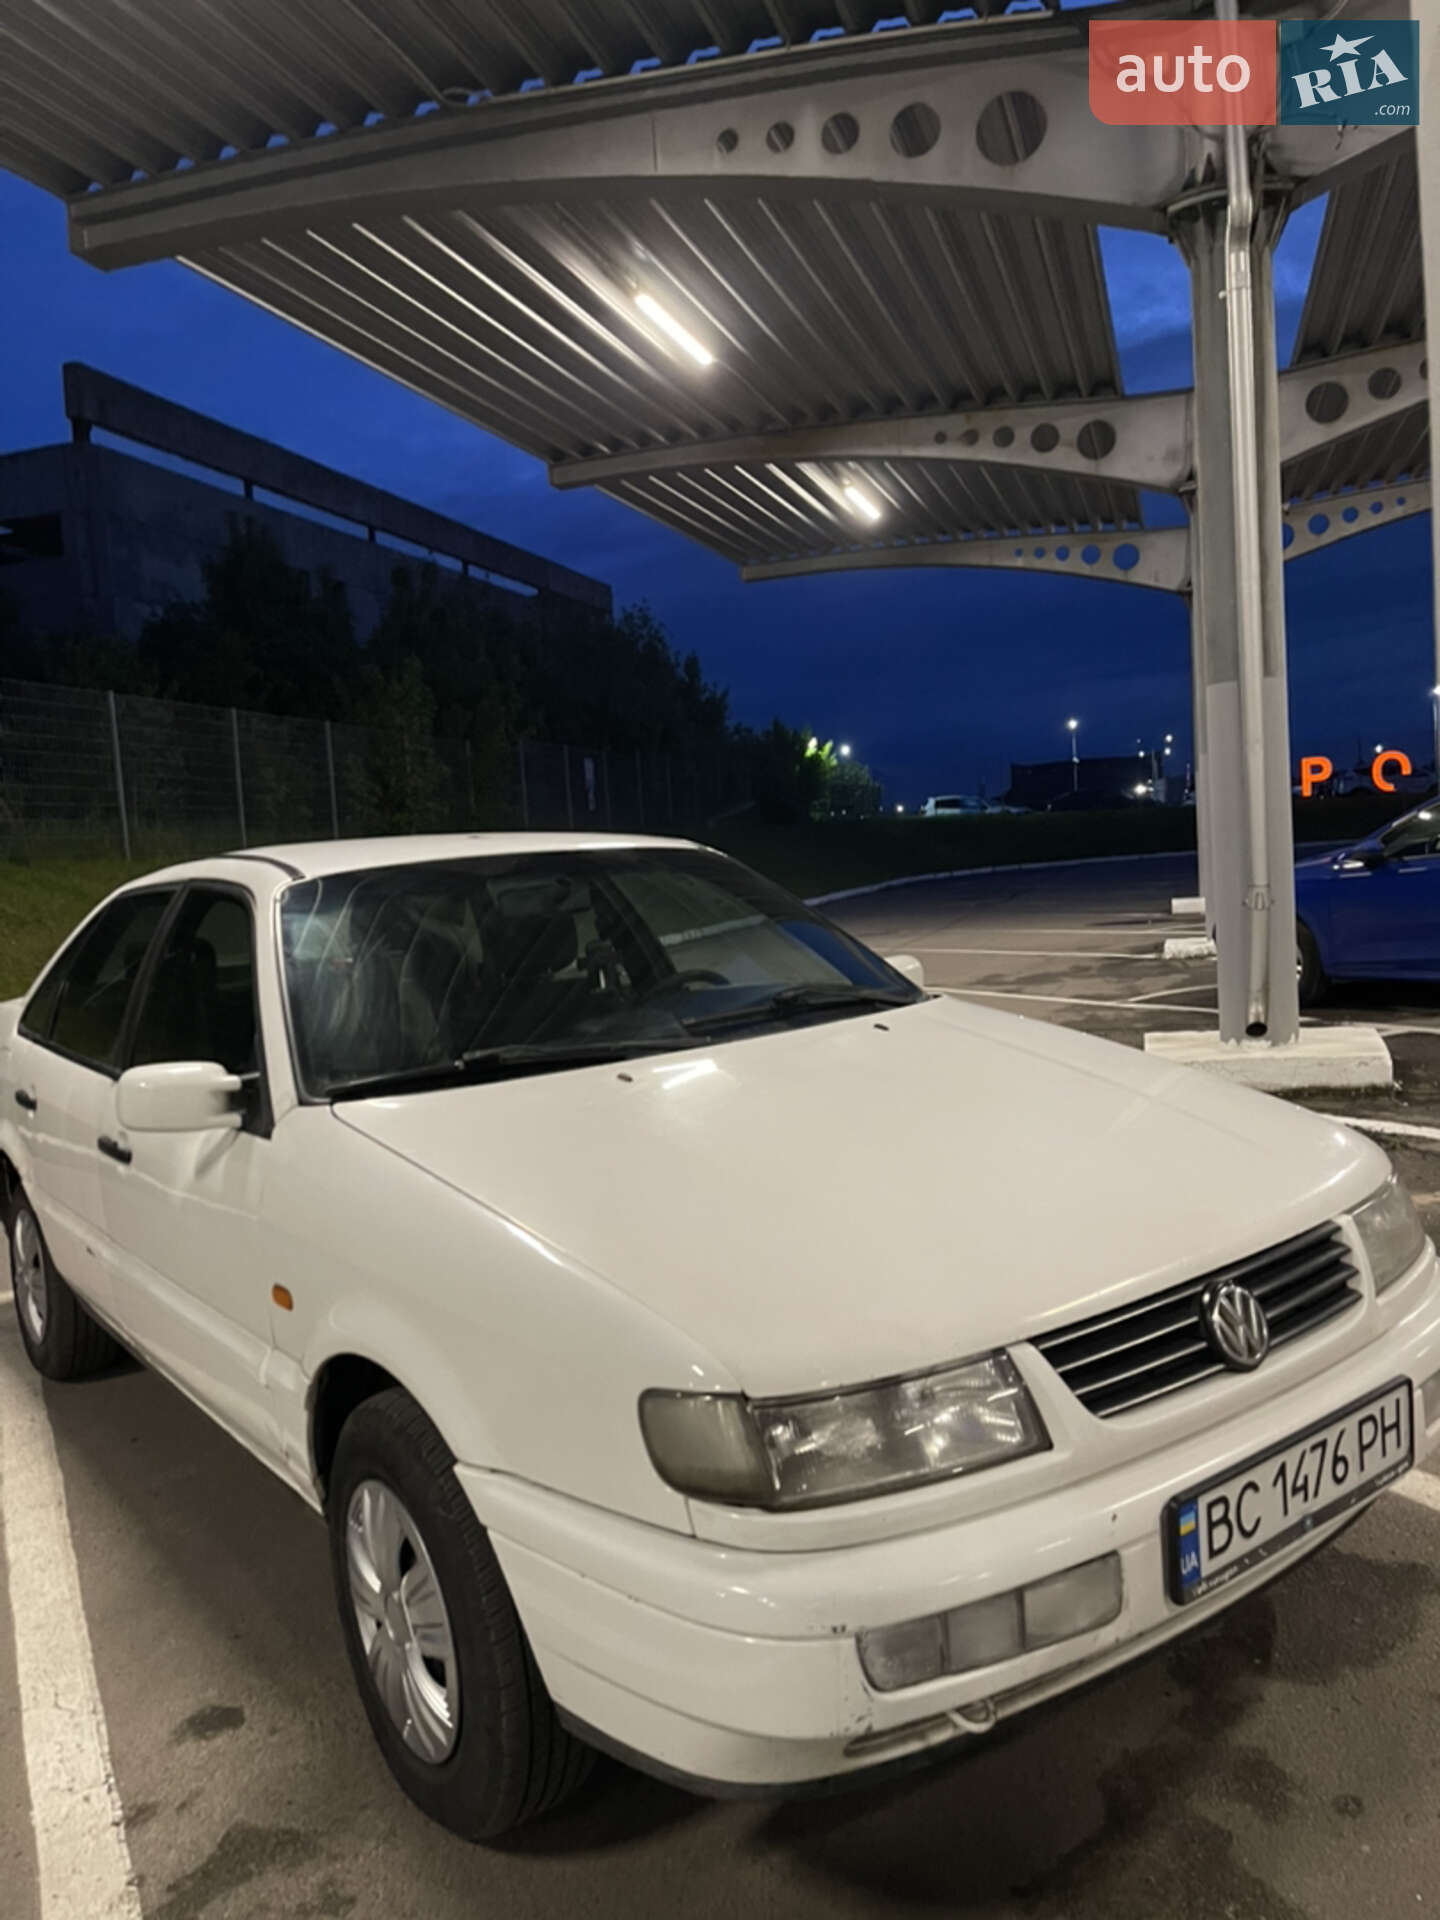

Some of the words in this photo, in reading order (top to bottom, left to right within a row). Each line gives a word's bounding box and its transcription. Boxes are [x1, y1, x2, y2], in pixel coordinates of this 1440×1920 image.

[1206, 1480, 1262, 1560] BC
[1272, 1427, 1350, 1517] 1476
[1357, 1397, 1401, 1473] PH
[1180, 1550, 1199, 1576] UA
